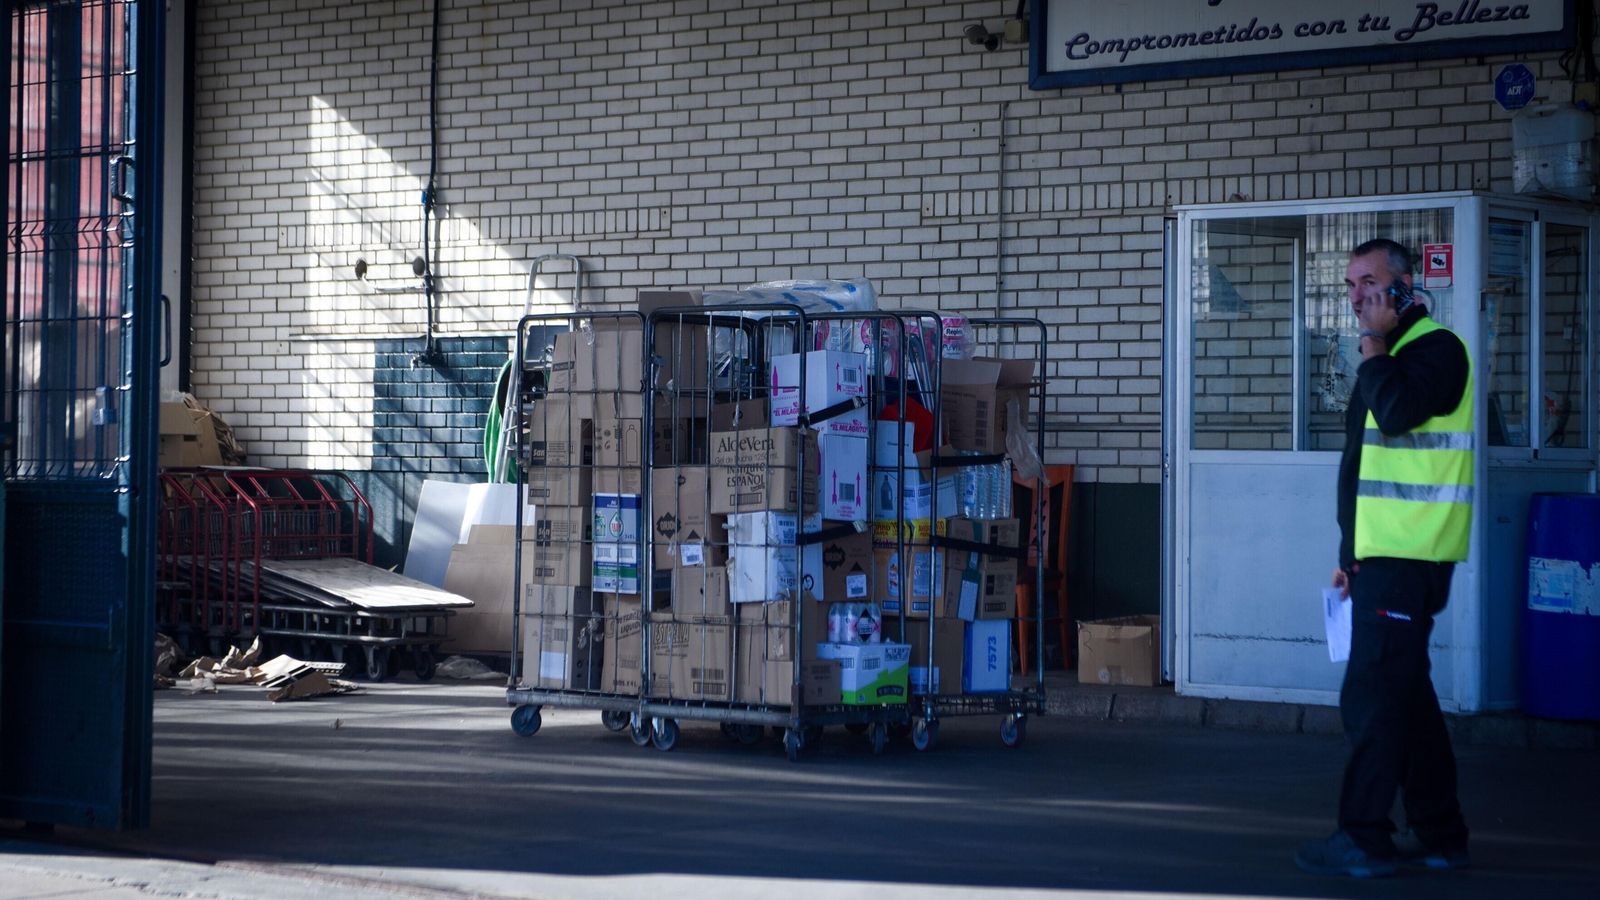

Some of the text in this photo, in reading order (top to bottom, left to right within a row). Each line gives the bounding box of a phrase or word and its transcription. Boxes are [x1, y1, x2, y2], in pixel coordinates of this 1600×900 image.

[1065, 0, 1530, 62] Comprometidos con tu Belleza
[1507, 86, 1523, 96] ADT
[988, 636, 997, 673] 7573
